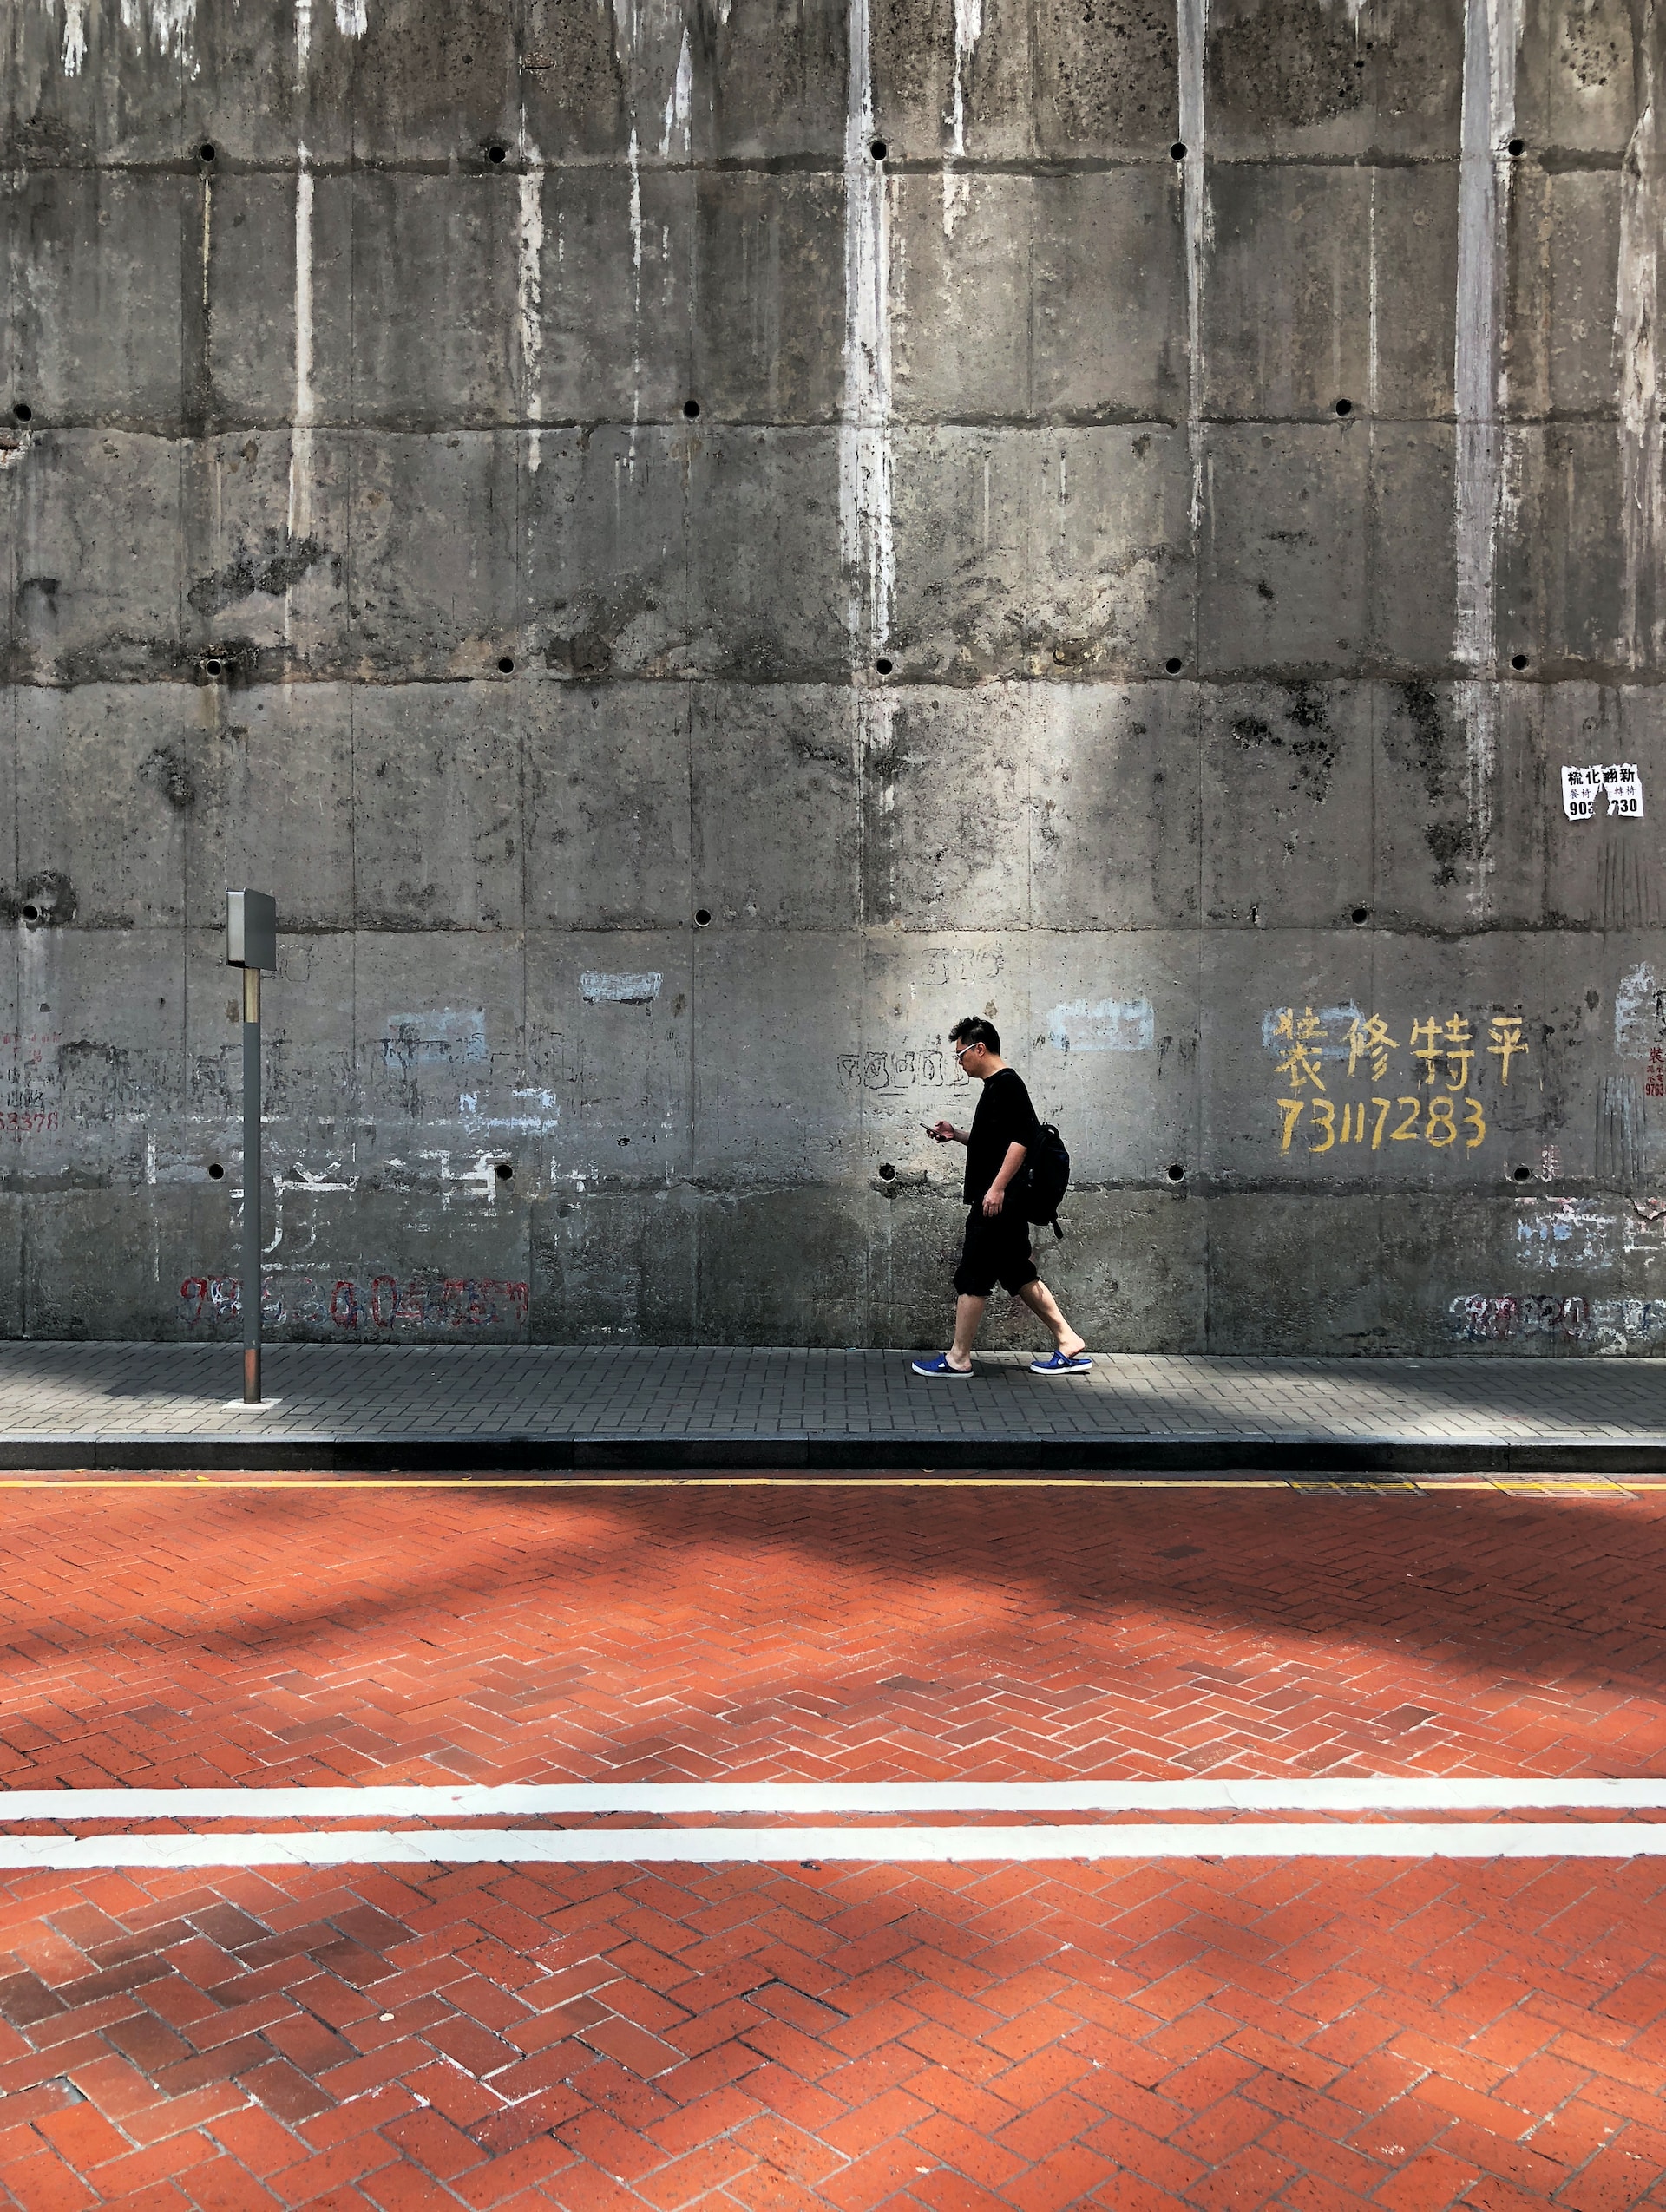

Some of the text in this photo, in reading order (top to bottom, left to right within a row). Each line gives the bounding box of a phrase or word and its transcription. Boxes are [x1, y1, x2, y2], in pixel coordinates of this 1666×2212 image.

[1274, 1005, 1529, 1092] 裝修特平
[1645, 1083, 1666, 1096] 9763
[1276, 1096, 1487, 1157] 73117283
